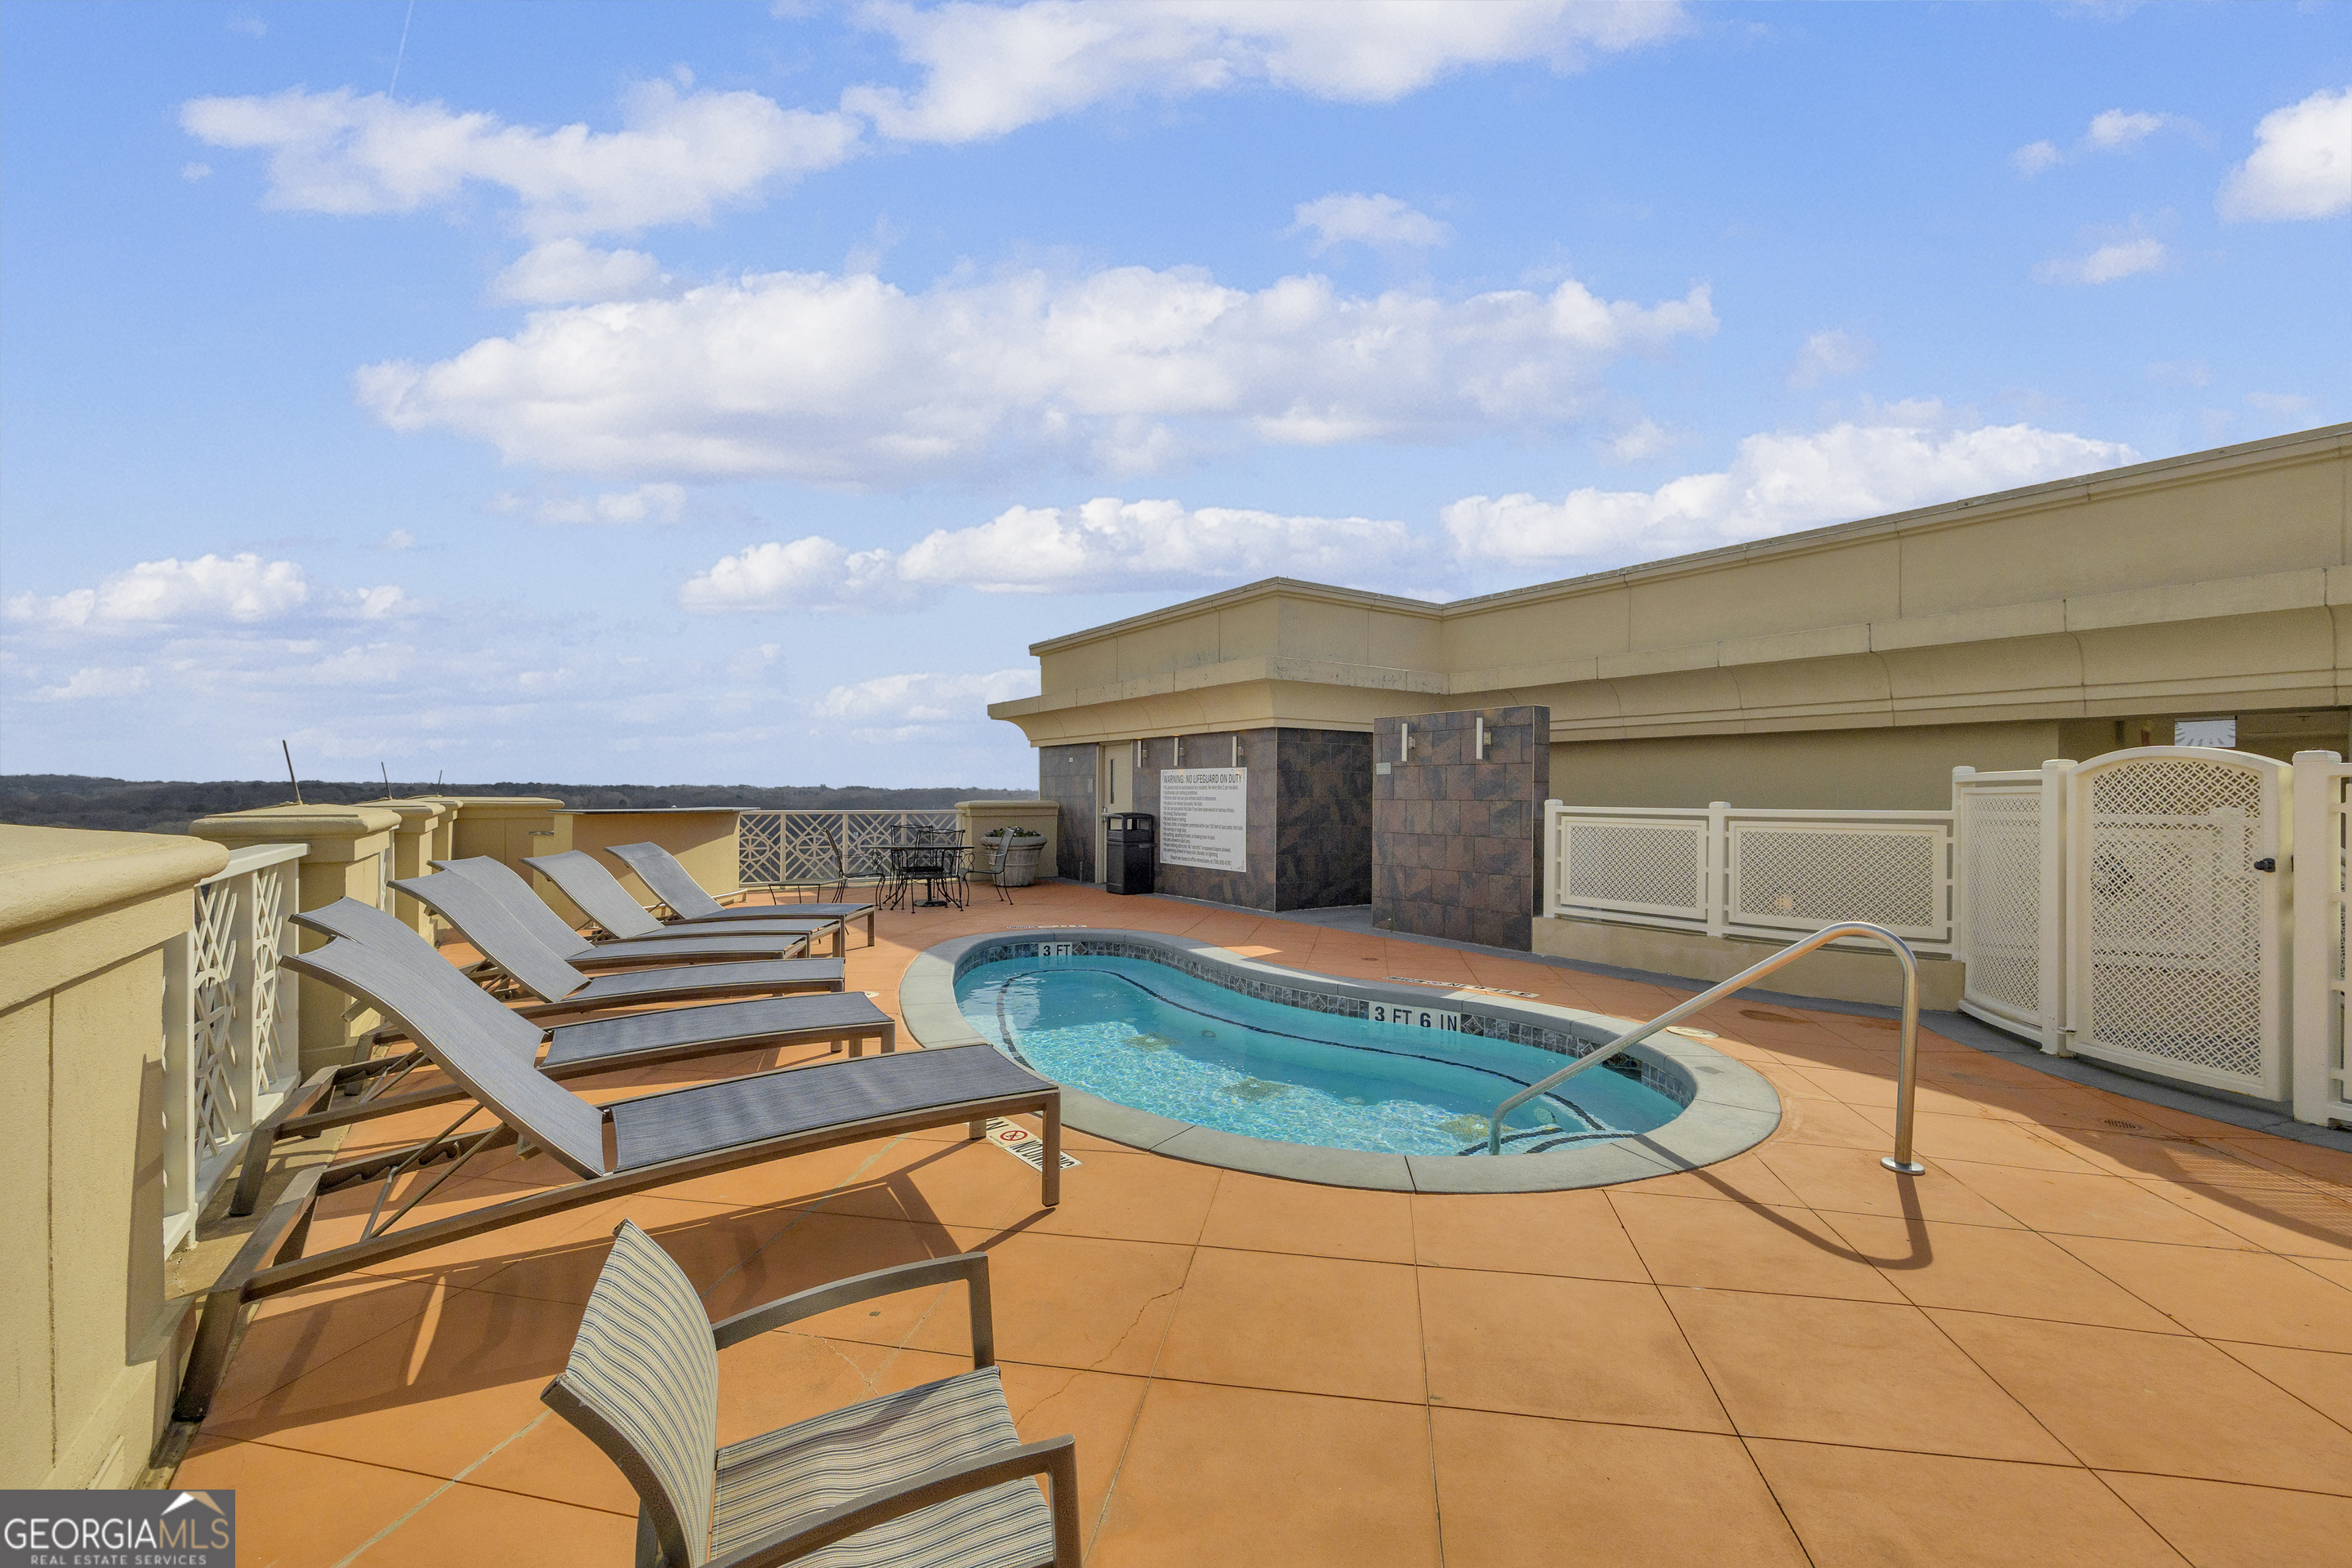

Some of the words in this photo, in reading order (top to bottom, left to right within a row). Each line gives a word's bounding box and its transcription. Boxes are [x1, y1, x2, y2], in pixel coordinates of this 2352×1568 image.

[1164, 775, 1185, 783] WARNING:
[1186, 775, 1192, 783] NO
[1193, 774, 1219, 783] LIFEGUARD
[1220, 774, 1227, 783] ON
[1229, 774, 1242, 783] DUTY
[1043, 945, 1051, 956] 3
[1056, 944, 1071, 956] FT
[1374, 1006, 1385, 1022] 3
[1393, 1008, 1412, 1025] FT
[1420, 1012, 1431, 1028] 6
[1440, 1014, 1457, 1031] IN
[1009, 1140, 1043, 1153] NO
